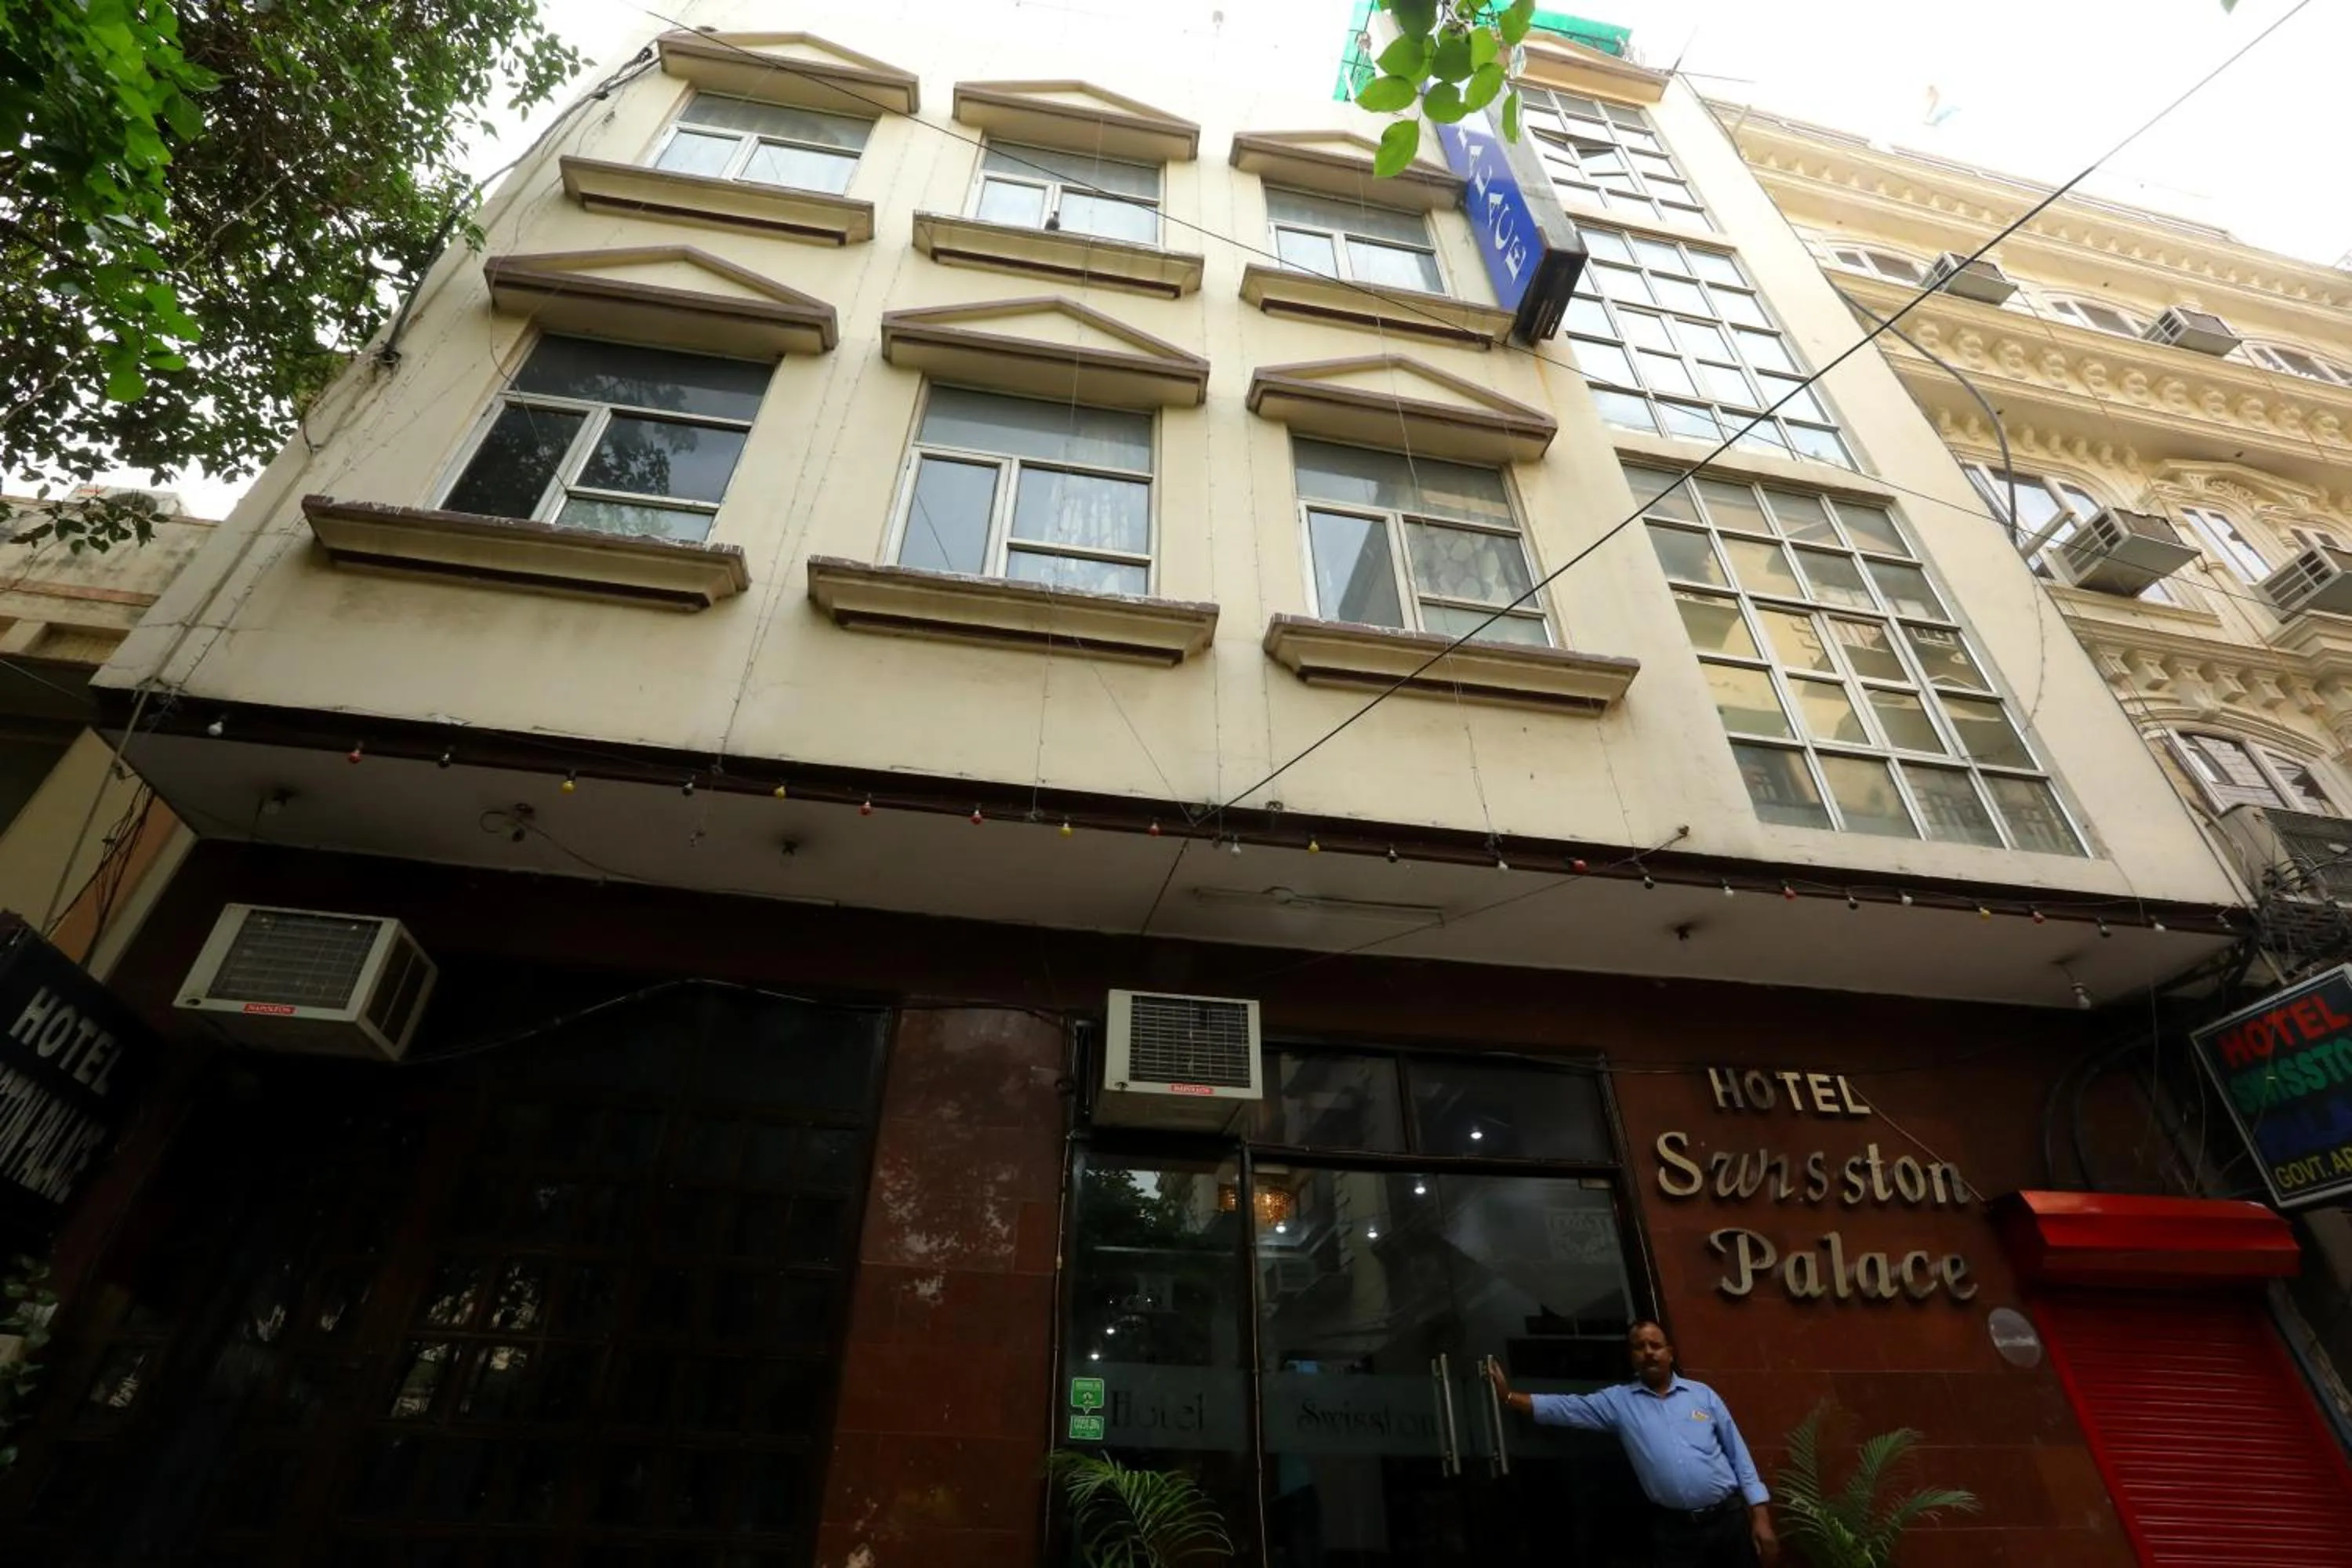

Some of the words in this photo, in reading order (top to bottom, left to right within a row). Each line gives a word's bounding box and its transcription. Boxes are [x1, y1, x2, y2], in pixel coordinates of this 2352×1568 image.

[8, 985, 124, 1096] HOTEL
[2218, 993, 2352, 1068] HOTEL
[1708, 1067, 1871, 1114] HOTEL
[1657, 1132, 1971, 1204] Swisston
[1709, 1228, 1978, 1301] Palace
